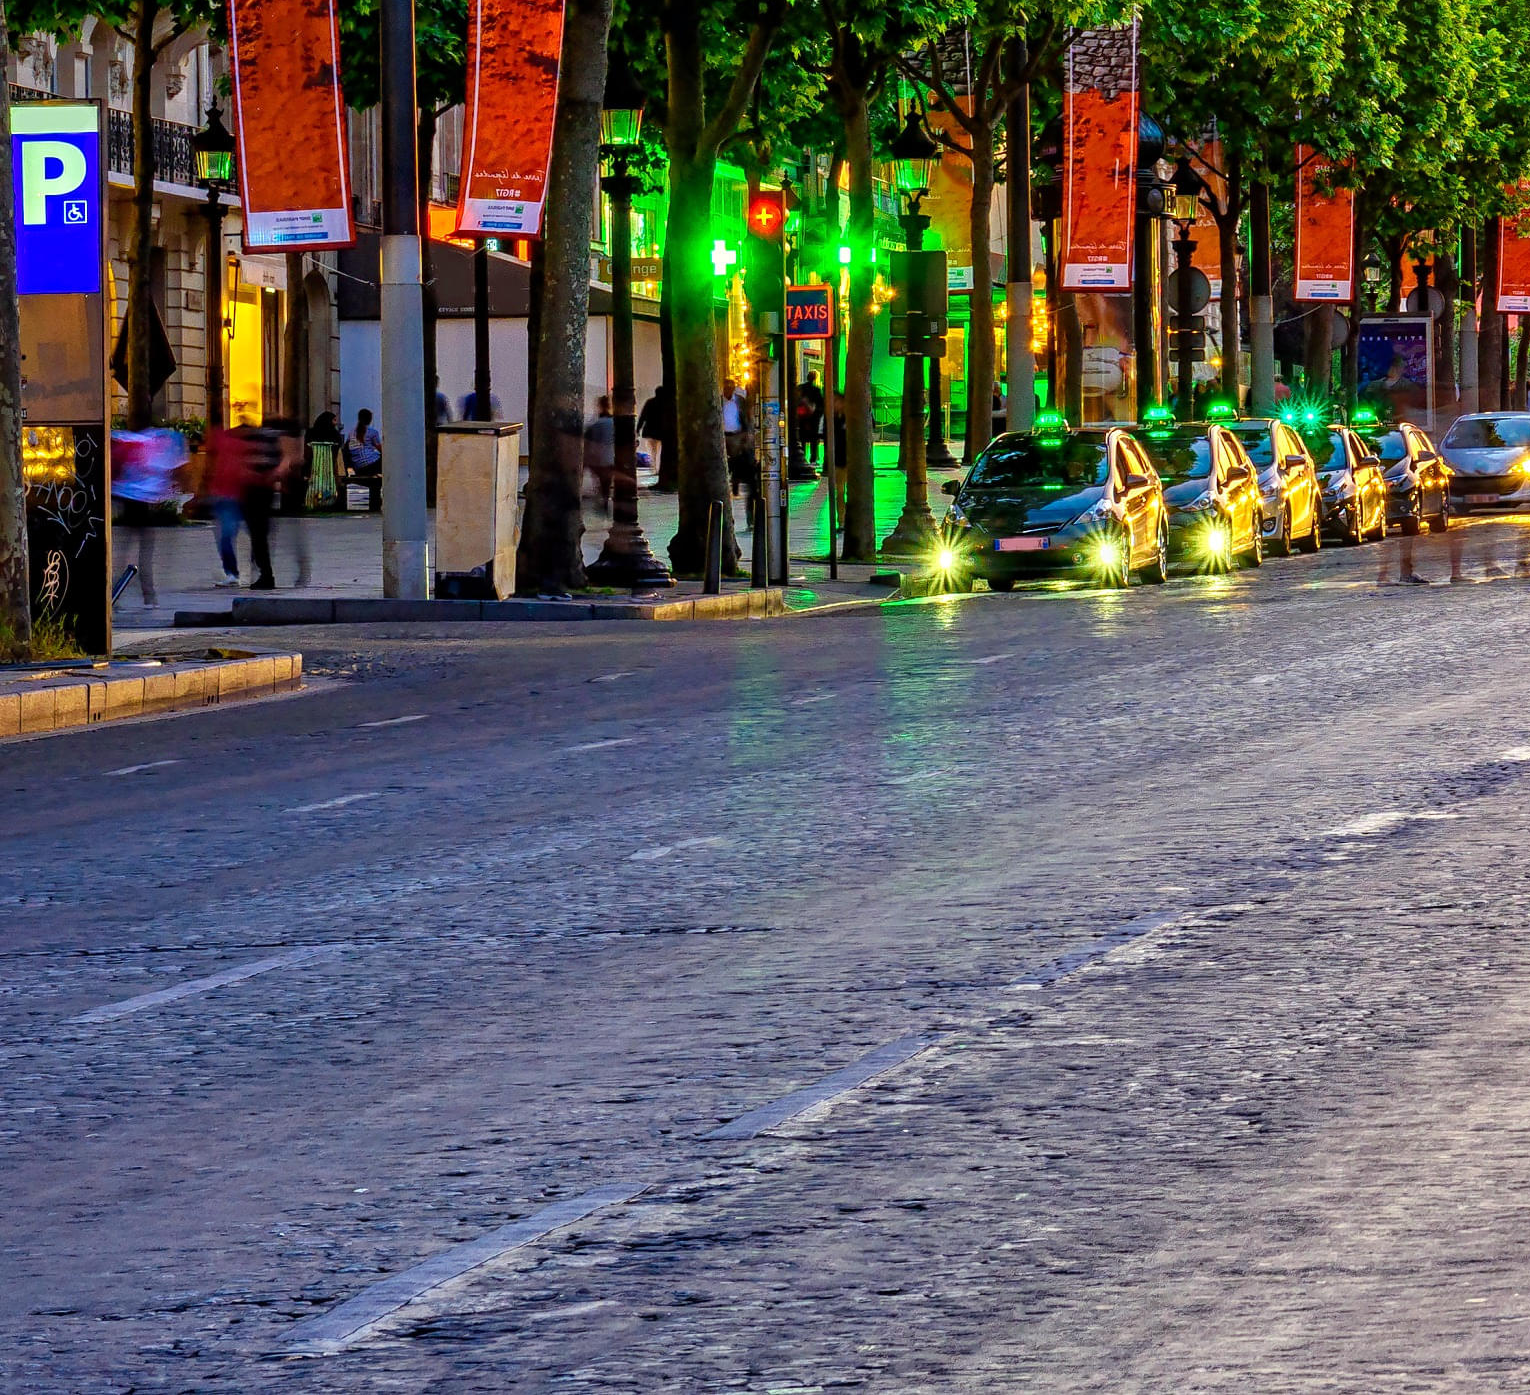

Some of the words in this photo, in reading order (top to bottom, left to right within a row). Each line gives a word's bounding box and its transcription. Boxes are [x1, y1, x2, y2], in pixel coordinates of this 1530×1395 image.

[22, 141, 87, 225] P
[607, 262, 657, 276] Cnge
[787, 305, 828, 320] TAXIS
